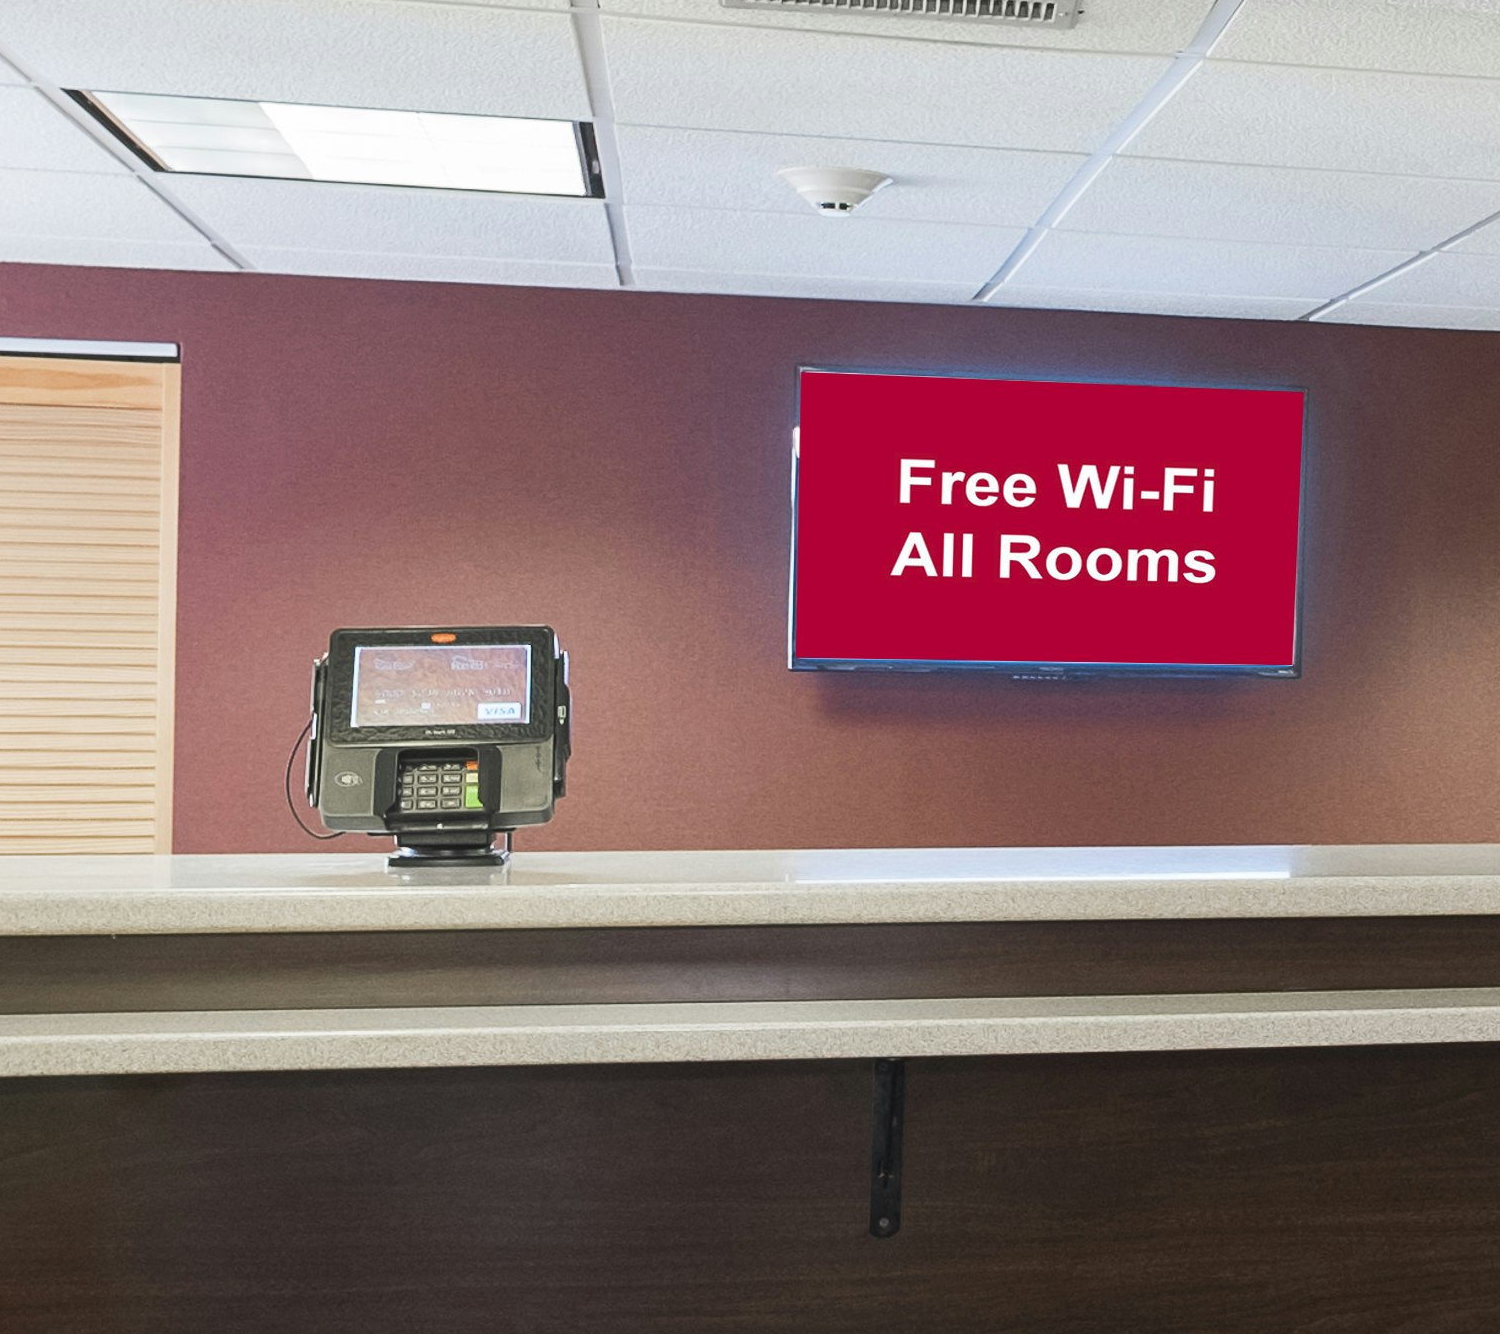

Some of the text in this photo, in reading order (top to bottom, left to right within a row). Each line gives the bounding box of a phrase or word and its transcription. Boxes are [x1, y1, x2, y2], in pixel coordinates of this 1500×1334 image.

[899, 458, 1215, 513] Free Wi-Fi
[890, 532, 1216, 584] All Rooms
